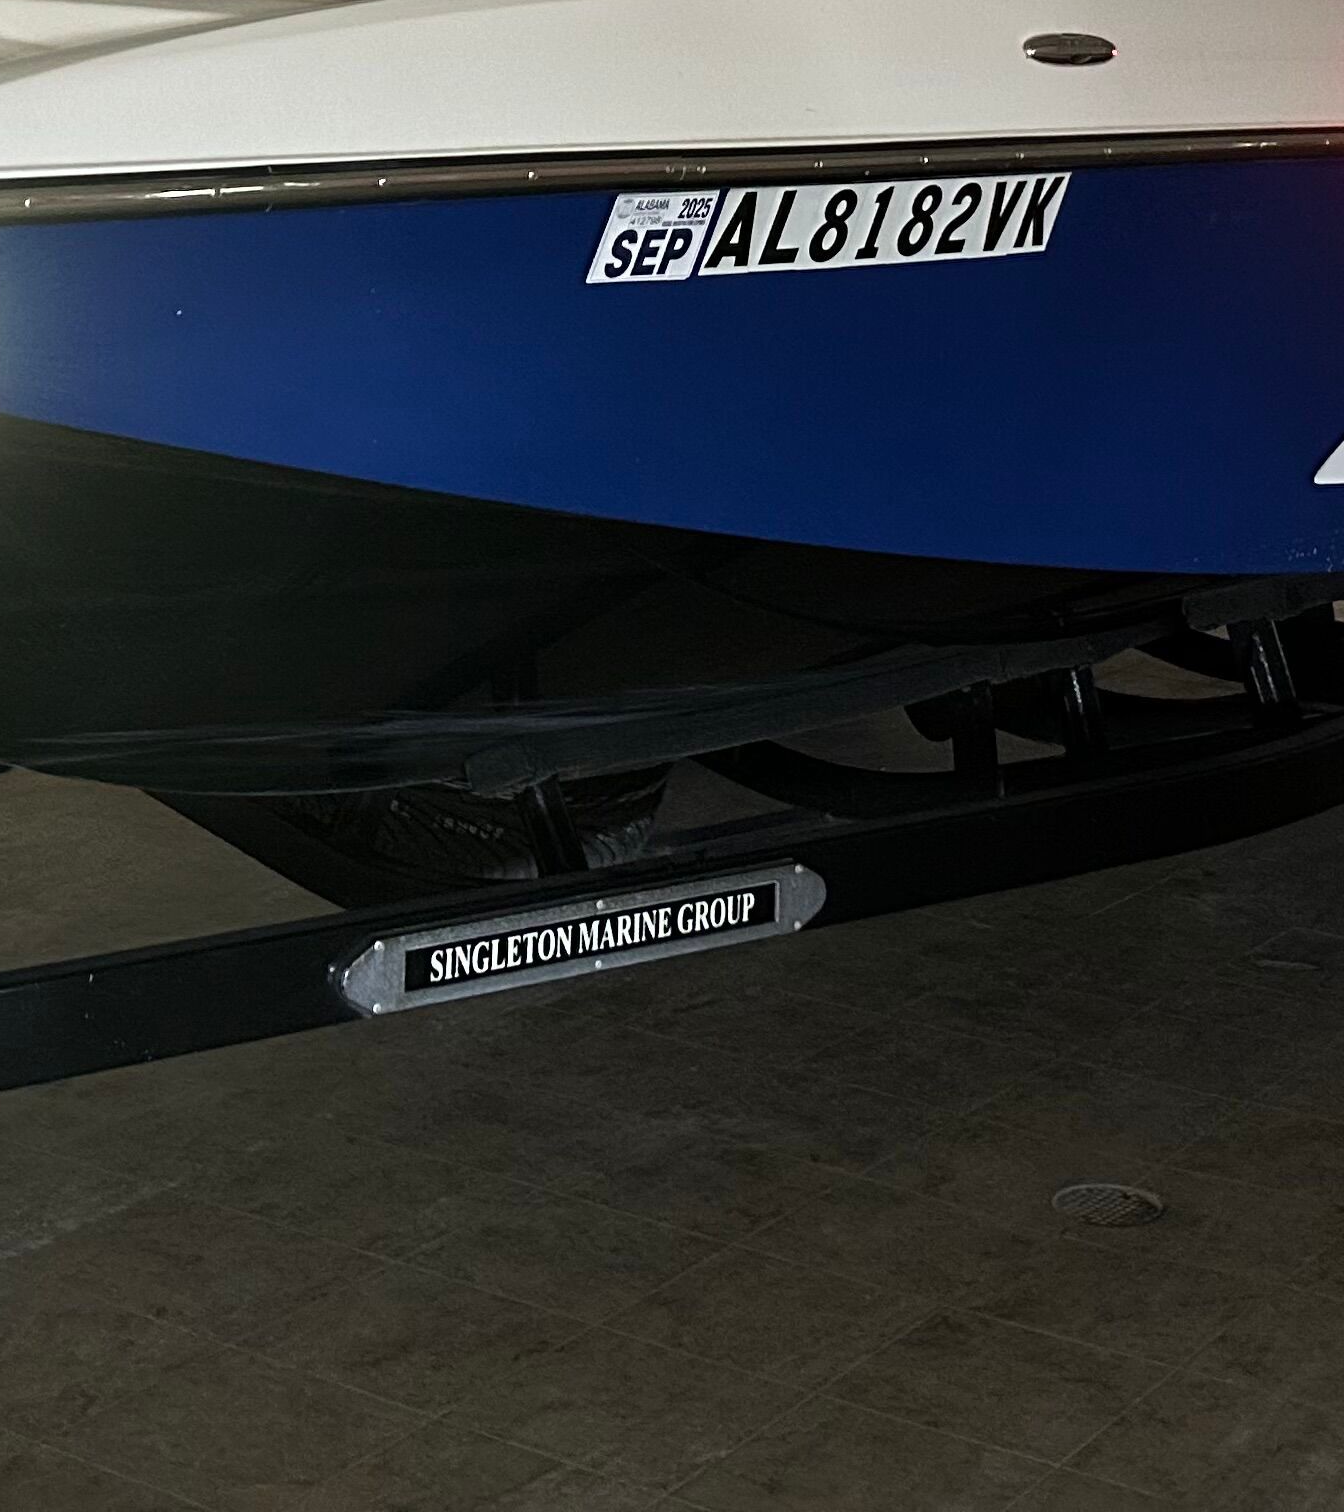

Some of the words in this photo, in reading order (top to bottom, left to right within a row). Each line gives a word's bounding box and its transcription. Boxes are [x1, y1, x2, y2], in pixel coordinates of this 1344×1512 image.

[635, 198, 671, 211] ALABAMA
[678, 197, 714, 219] 2025
[704, 176, 1065, 269] AL8182VK
[604, 227, 694, 279] SEP
[429, 925, 574, 983] SINGLETON
[578, 908, 672, 953] MARINE
[676, 891, 756, 935] GROUP
